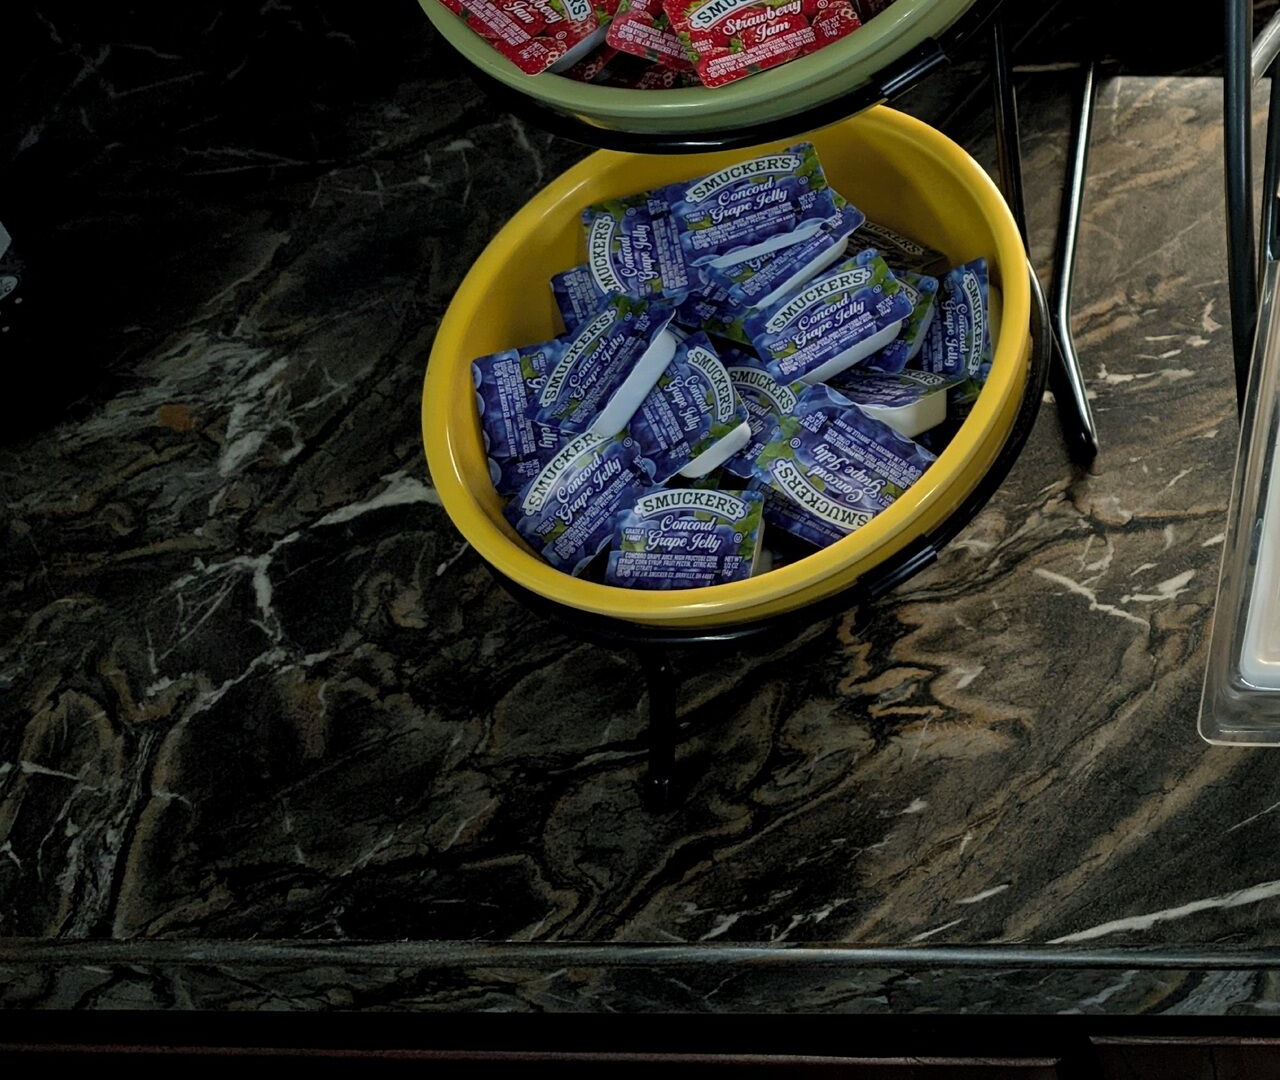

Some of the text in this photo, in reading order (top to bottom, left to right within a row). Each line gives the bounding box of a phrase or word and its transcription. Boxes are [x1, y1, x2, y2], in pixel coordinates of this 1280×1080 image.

[503, 1, 534, 25] Jam
[723, 0, 801, 36] Strawberry
[755, 21, 790, 42] Jam
[693, 155, 792, 198] SMUCKER'S
[719, 177, 774, 205] Concord
[709, 188, 788, 223] Grape Jelly
[594, 221, 622, 292] SMUCKER'S
[621, 237, 635, 277] Concord
[632, 224, 659, 280] Grape Jelly
[773, 272, 863, 329] SMUCKER'S
[798, 294, 849, 331] Concord
[792, 300, 865, 347] Grape Jelly
[968, 280, 983, 372] SMUCKER'S
[545, 313, 611, 403] SMUCKER'S
[569, 337, 608, 387] Concord
[572, 333, 625, 400] Grape Jelly
[666, 376, 699, 431] Grape Jelly
[685, 375, 713, 414] Concord
[692, 352, 731, 417] SMUCKER'S
[730, 372, 793, 411] SMUCKER'S
[529, 433, 599, 508] SMUCKER
[556, 452, 603, 504] Concord
[557, 457, 622, 524] Grape Jelly
[807, 468, 864, 502] Concord
[813, 445, 886, 500] Grape Jelly
[643, 488, 739, 518] SMUCKER'S
[660, 513, 716, 534] Concord
[645, 529, 721, 553] Grape Jelly
